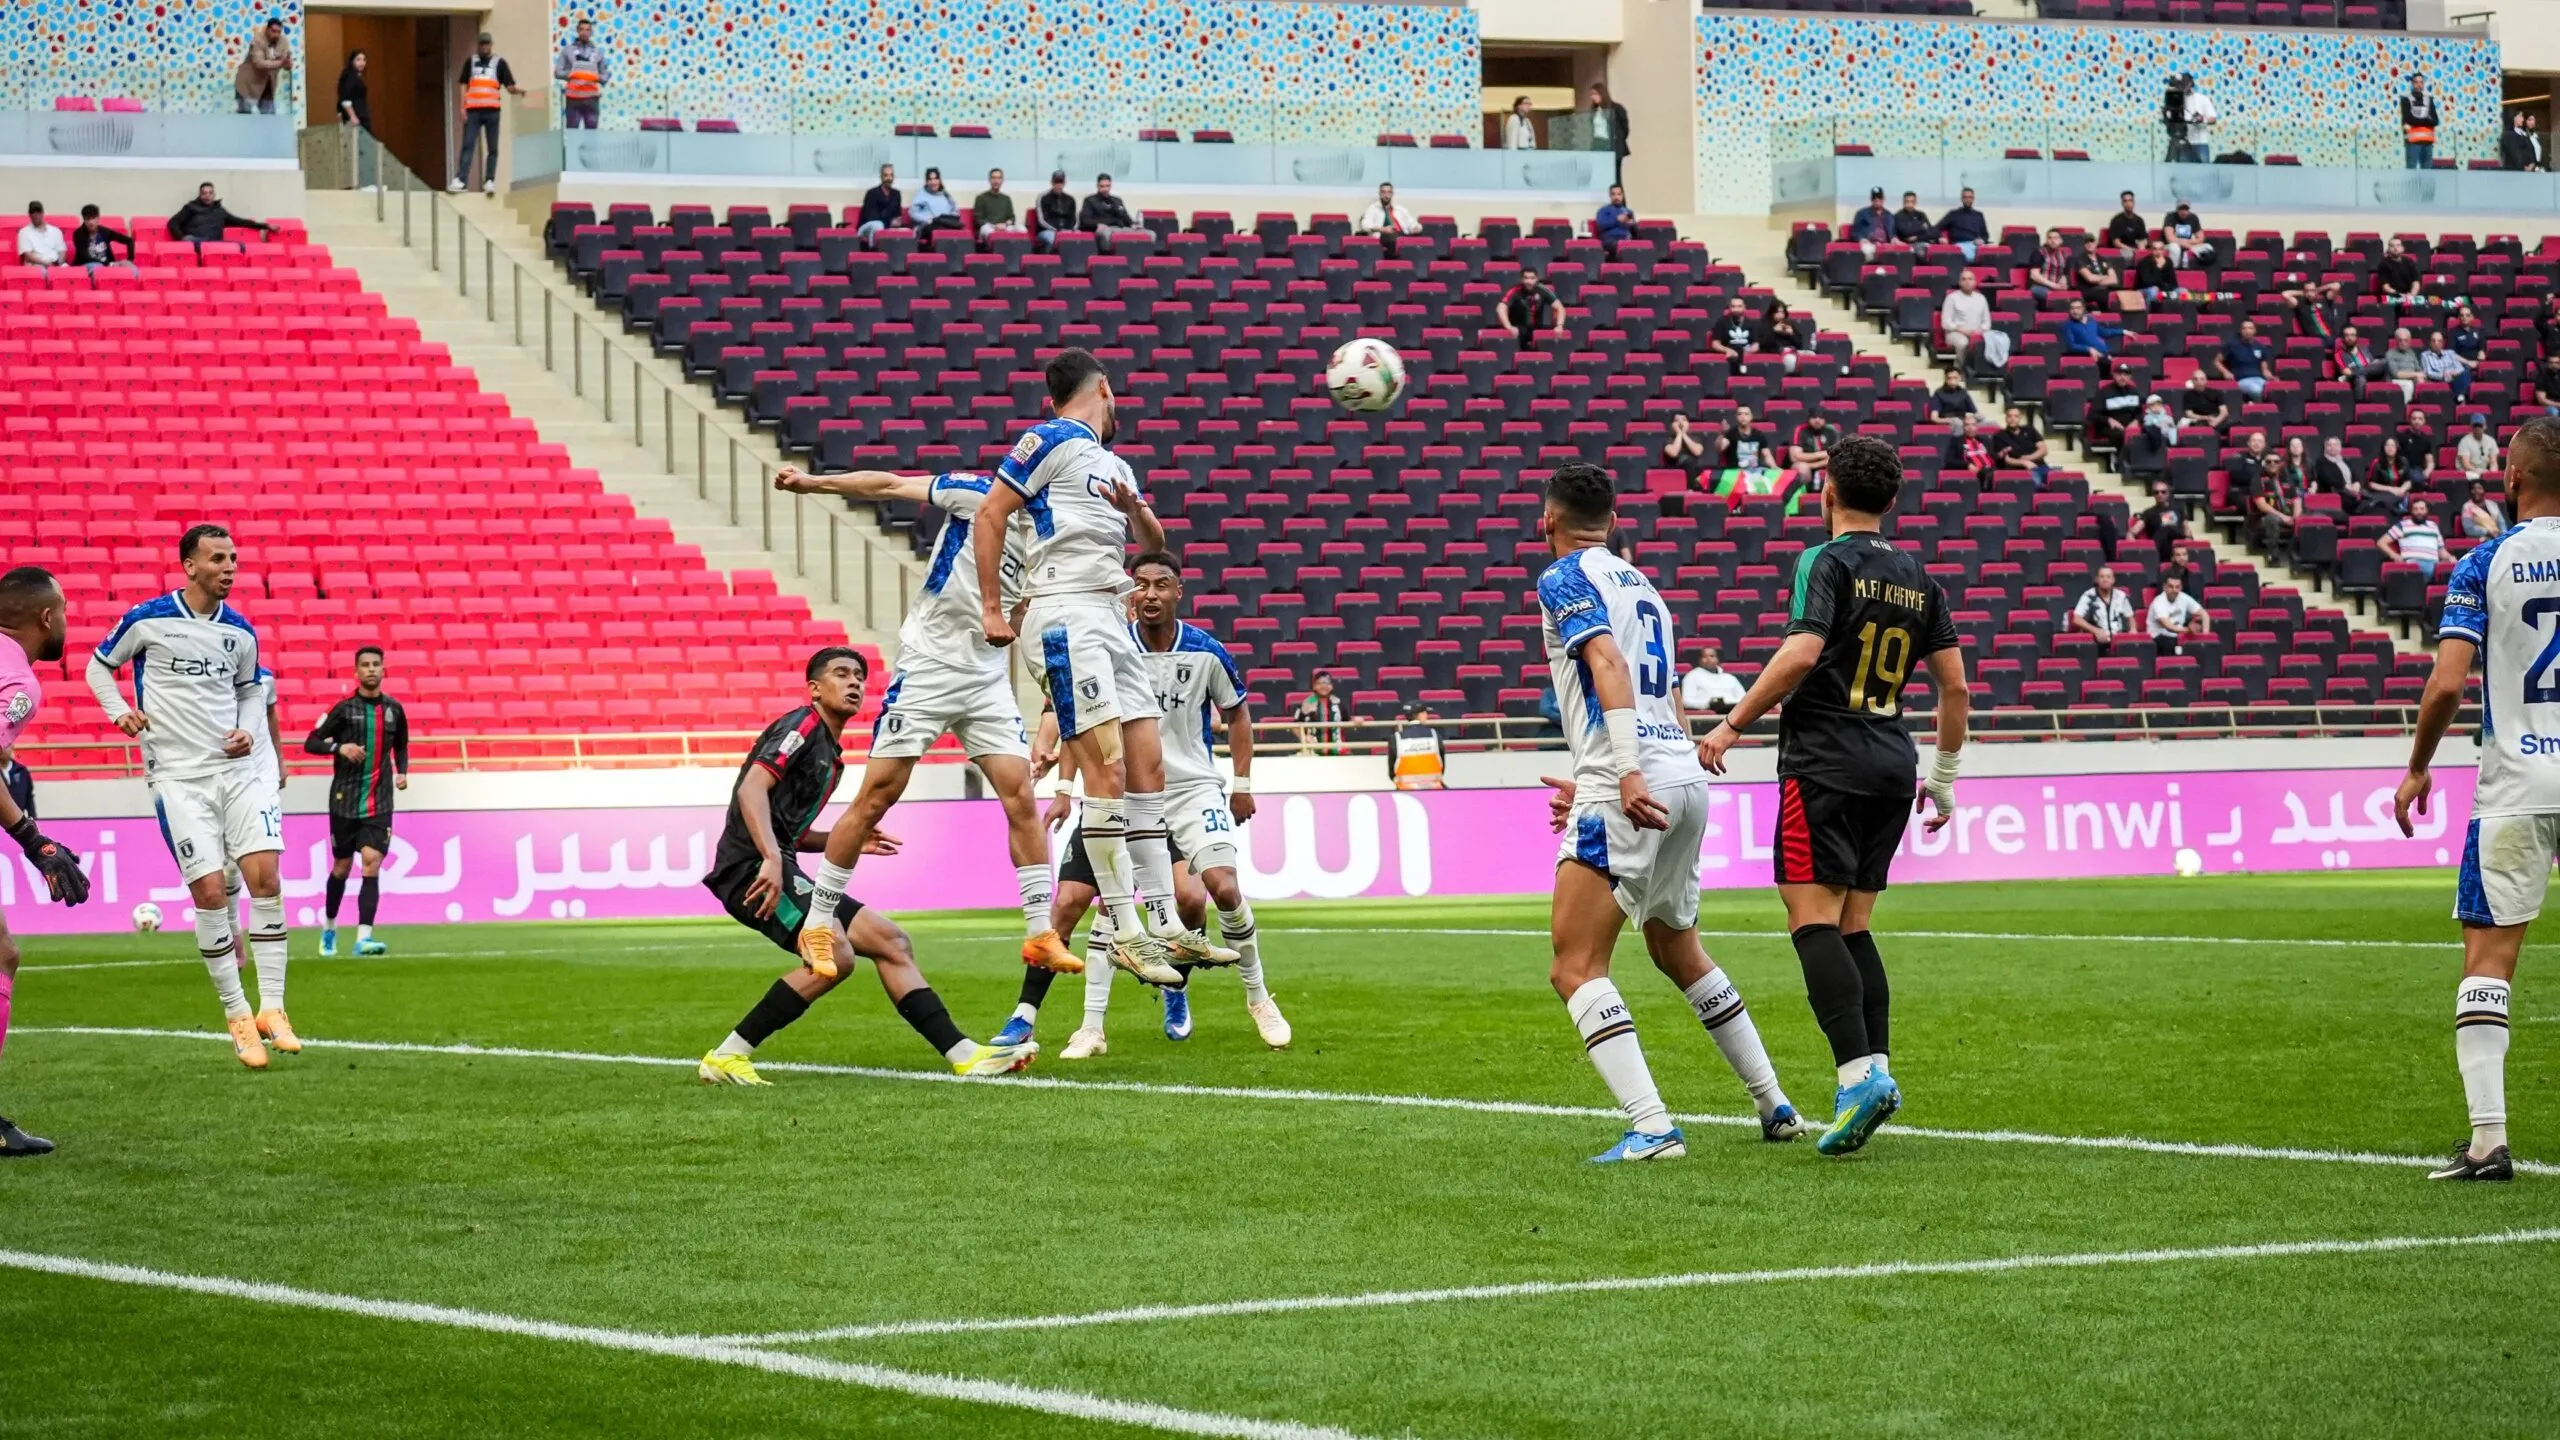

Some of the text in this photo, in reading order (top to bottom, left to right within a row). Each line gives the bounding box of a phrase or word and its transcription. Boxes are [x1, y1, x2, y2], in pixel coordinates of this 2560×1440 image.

[1635, 599, 1668, 699] 3
[1848, 621, 1911, 717] 19
[2520, 733, 2560, 756] Sm
[1202, 808, 1230, 833] 33
[2042, 782, 2184, 852] inwi
